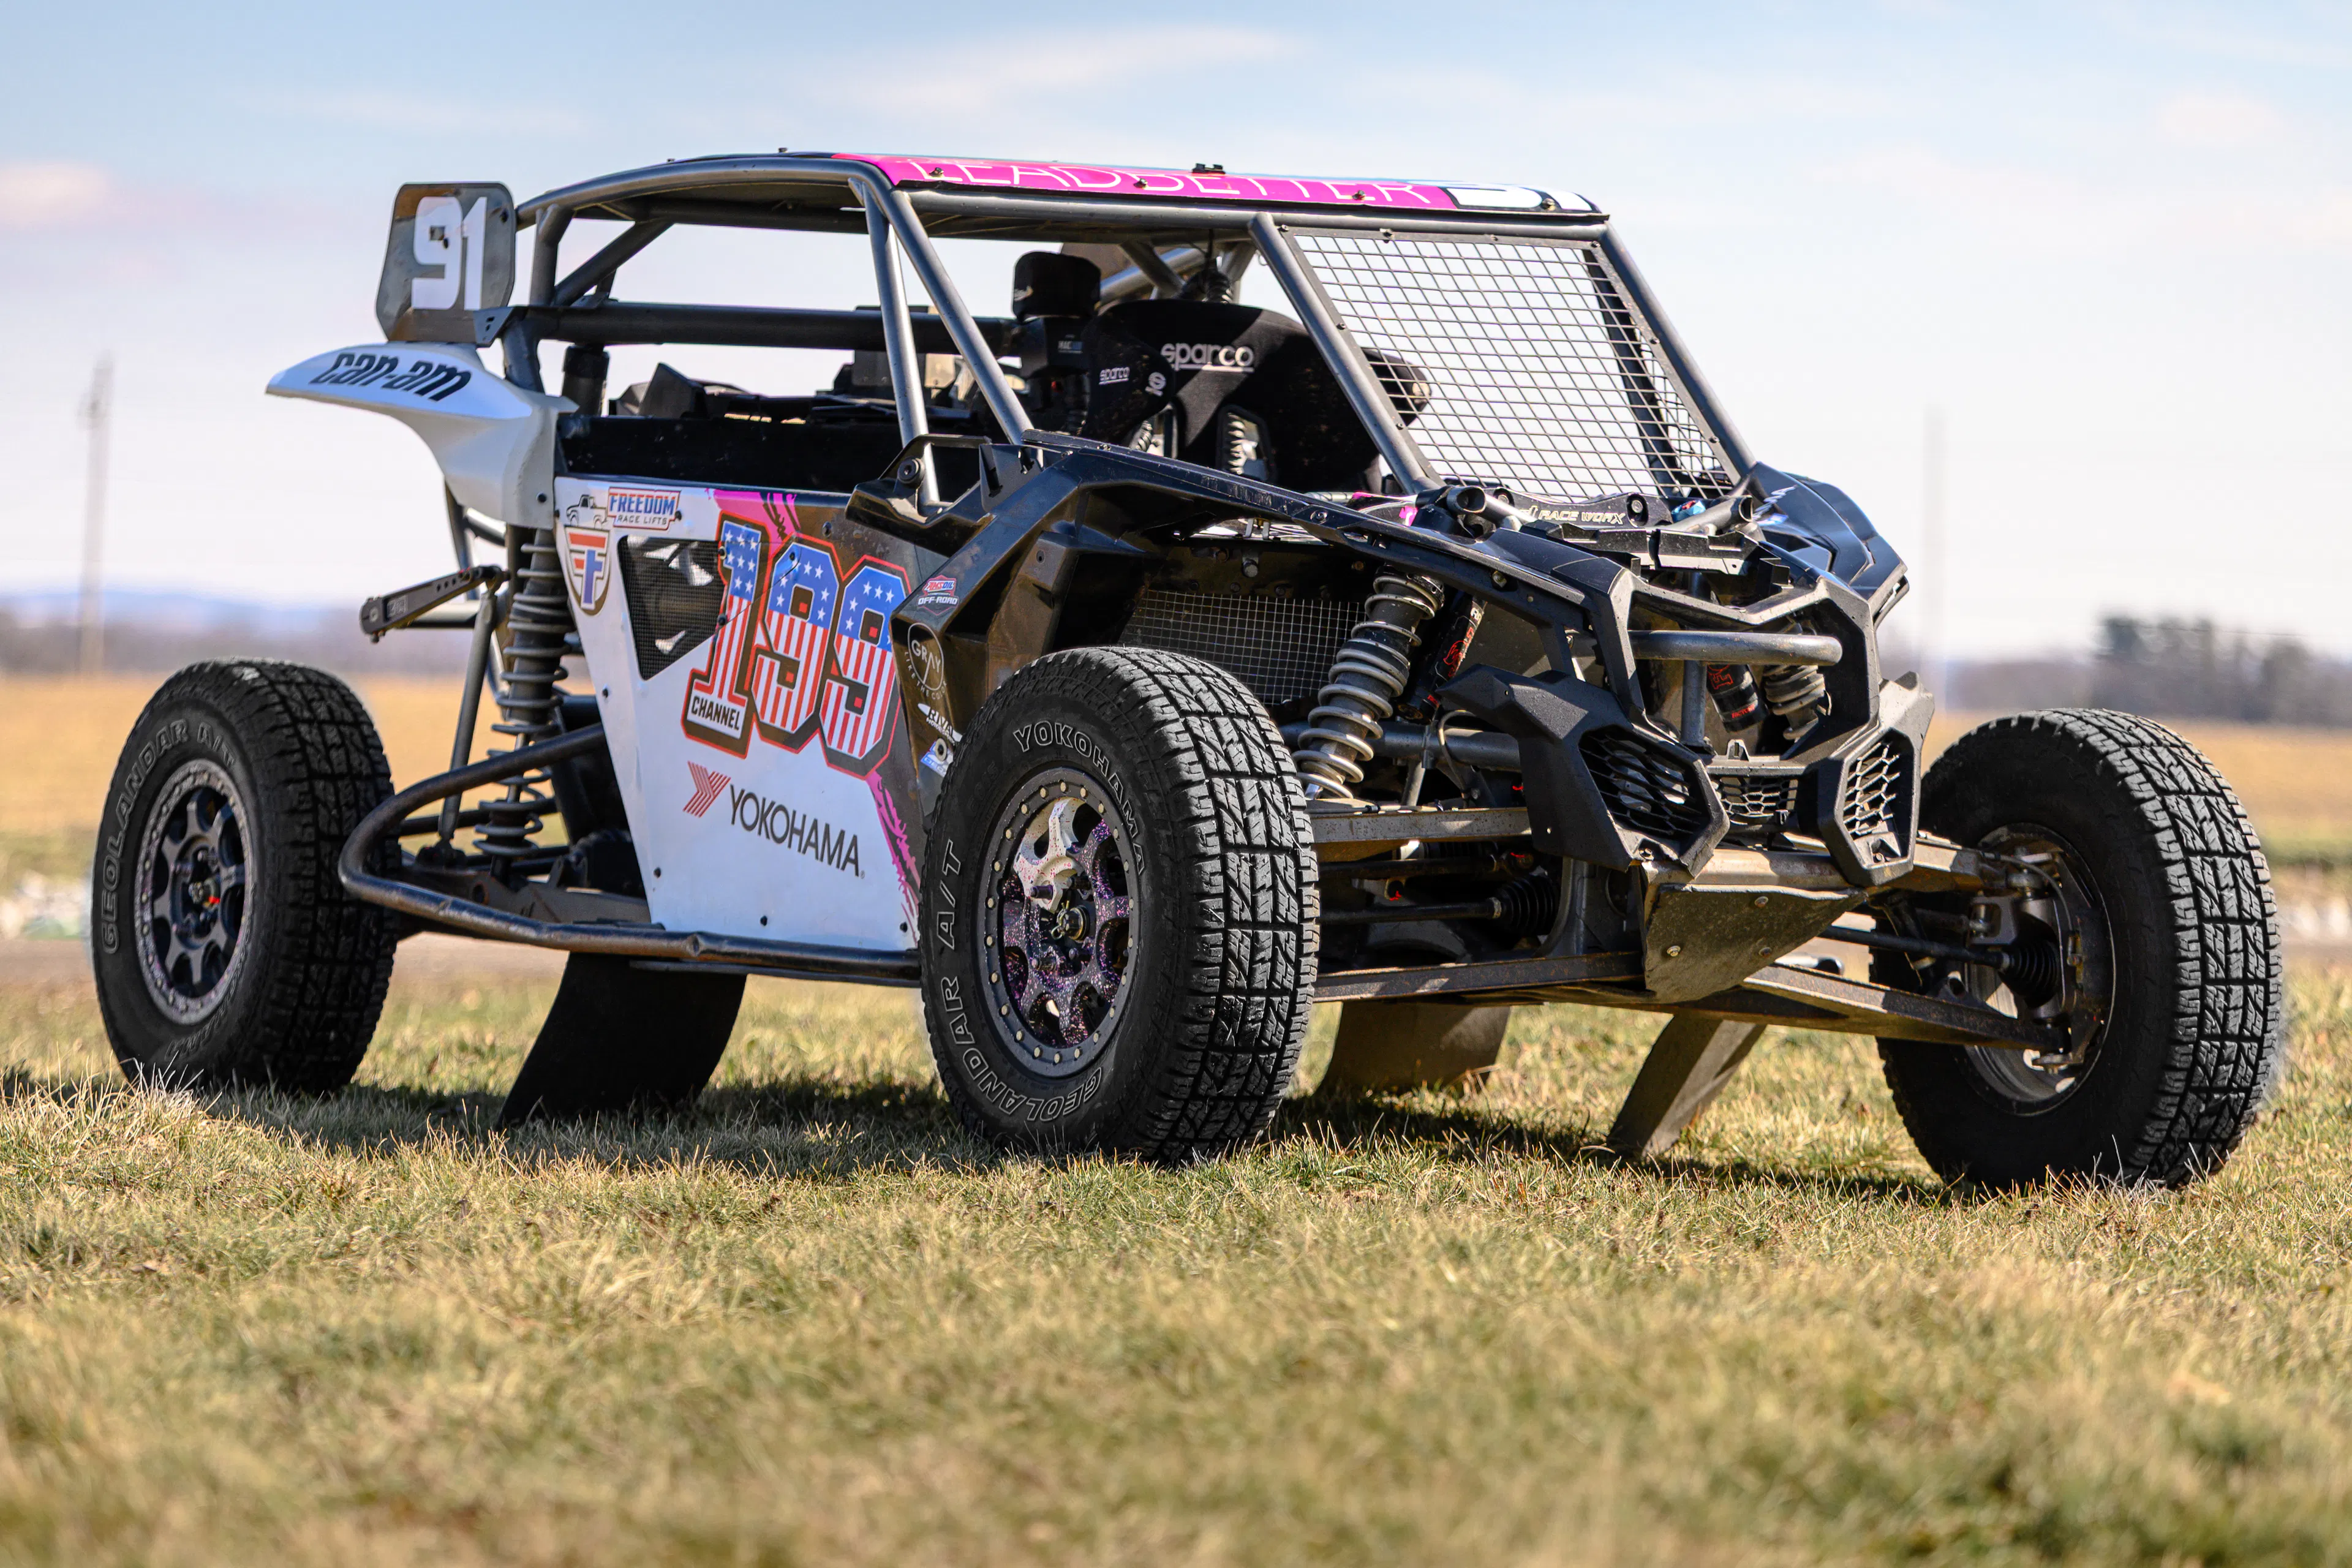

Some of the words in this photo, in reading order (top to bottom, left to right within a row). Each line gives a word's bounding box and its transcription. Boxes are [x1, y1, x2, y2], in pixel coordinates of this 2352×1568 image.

[411, 196, 487, 311] 91
[1161, 343, 1254, 371] sparco
[609, 492, 676, 515] FREEDOM
[617, 515, 639, 524] RACE
[644, 516, 667, 525] LIFTS
[1538, 510, 1579, 521] RACE
[1581, 512, 1626, 525] WORX
[925, 581, 954, 592] AMSOIL
[911, 639, 941, 685] GRAY
[691, 695, 740, 731] CHANNEL
[1014, 720, 1145, 875] YOKOHAMA
[101, 718, 189, 954] GEOLANDAR
[729, 784, 860, 877] YOKOHAMA
[937, 839, 962, 951] A/T
[941, 976, 1102, 1121] GEOLANDAR
